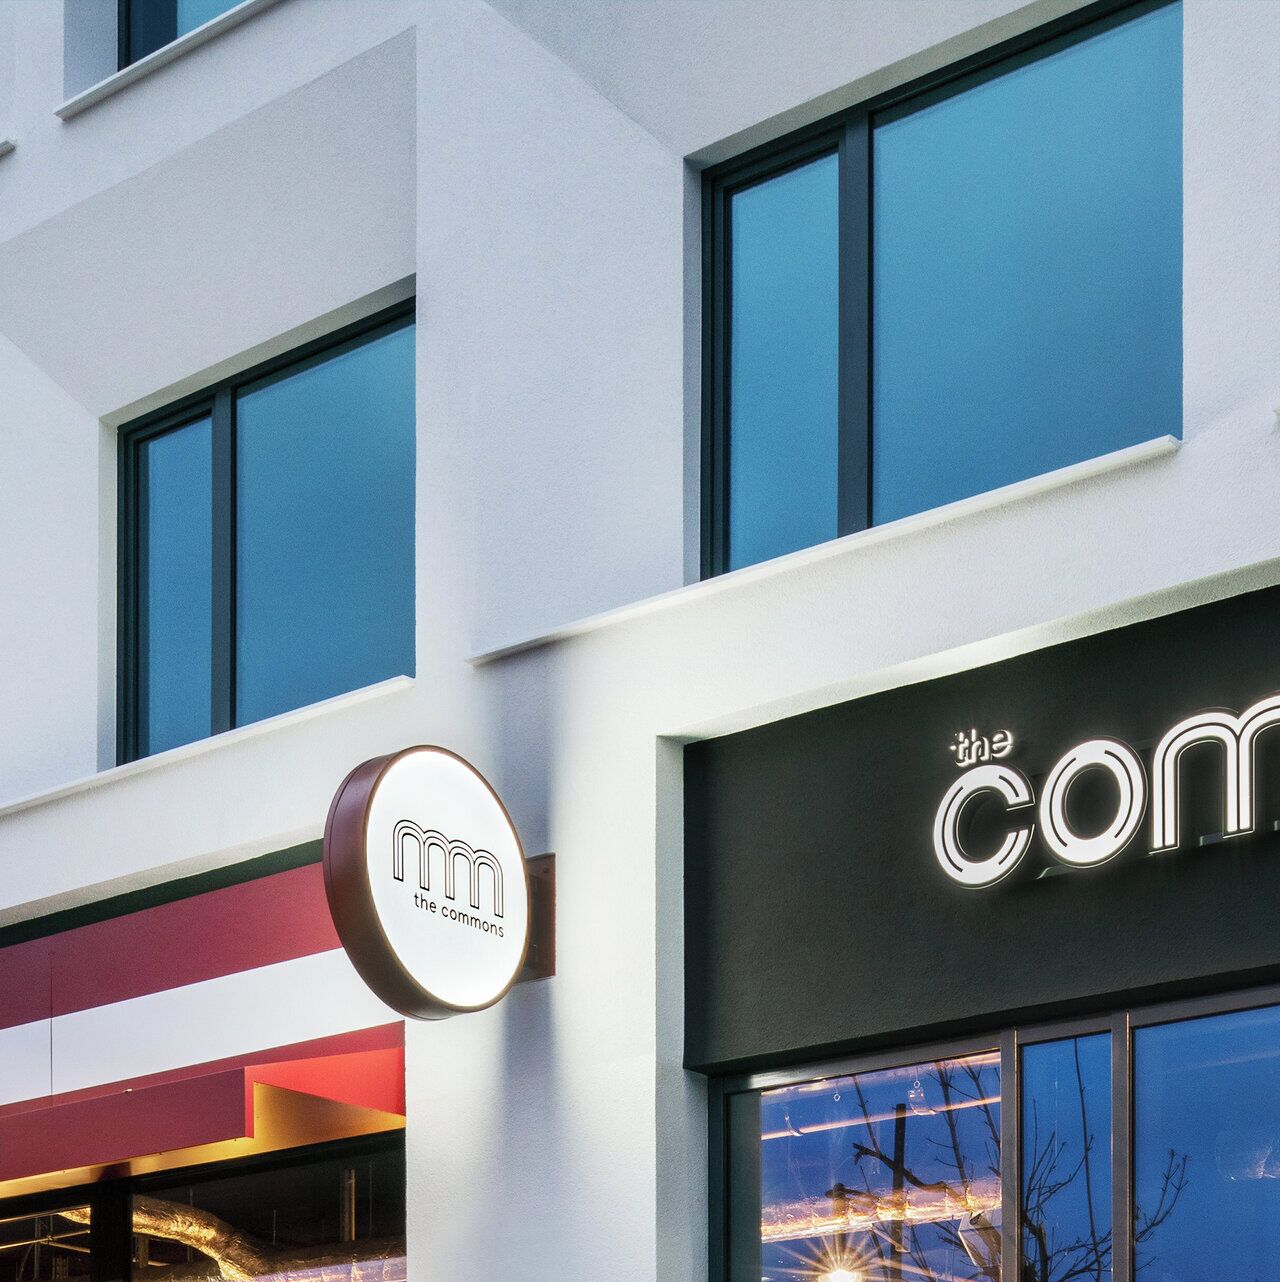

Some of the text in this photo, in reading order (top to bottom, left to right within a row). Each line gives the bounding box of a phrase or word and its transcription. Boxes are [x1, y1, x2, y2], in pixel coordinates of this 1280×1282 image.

[950, 728, 1014, 767] the
[414, 892, 505, 938] the commons
